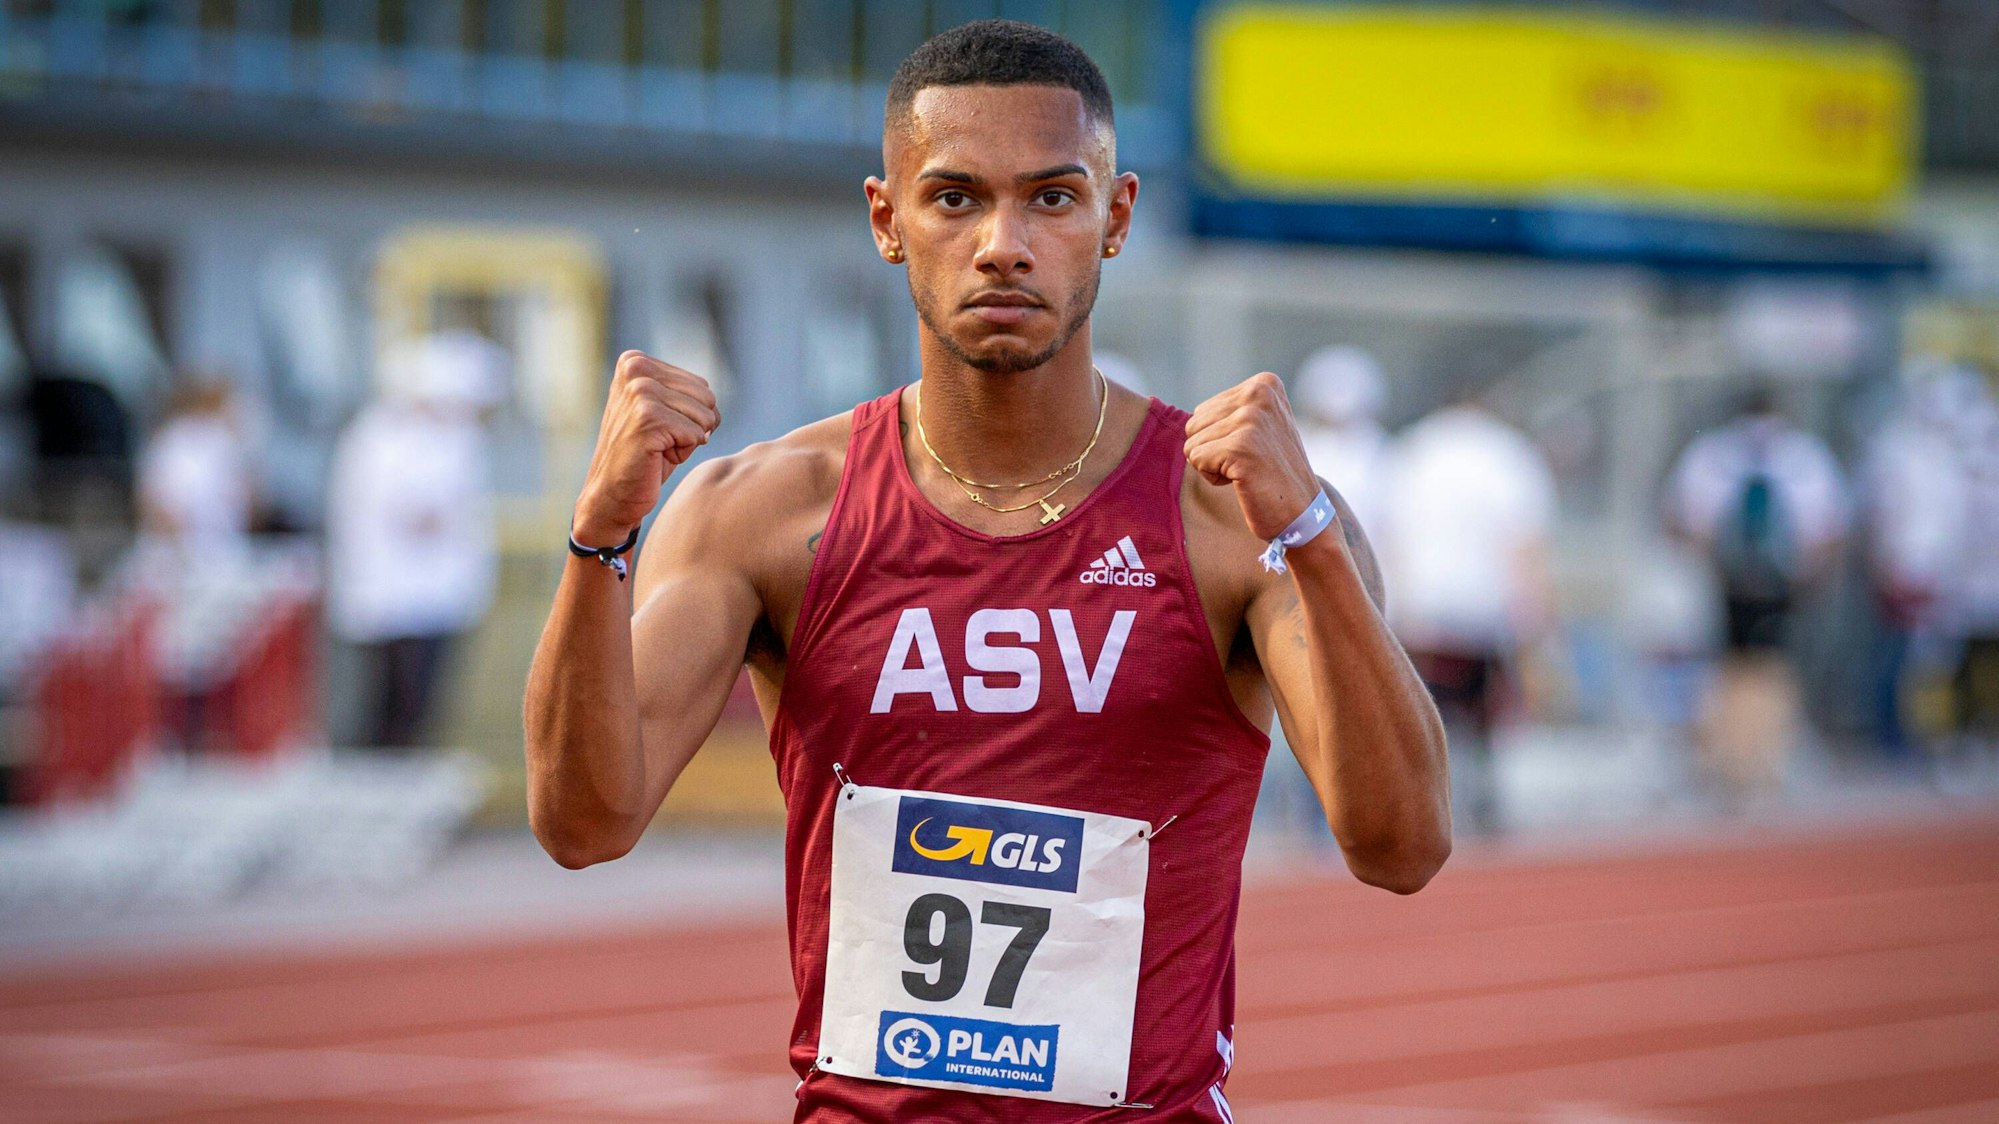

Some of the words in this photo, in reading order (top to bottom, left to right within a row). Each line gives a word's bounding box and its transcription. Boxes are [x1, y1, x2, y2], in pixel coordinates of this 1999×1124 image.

[1079, 566, 1156, 587] adidas
[869, 607, 1137, 714] ASV
[991, 832, 1065, 873] GLS
[901, 893, 1052, 1009] 97
[947, 1030, 1050, 1067] PLAN
[945, 1063, 1045, 1083] INTERNATIONAL
